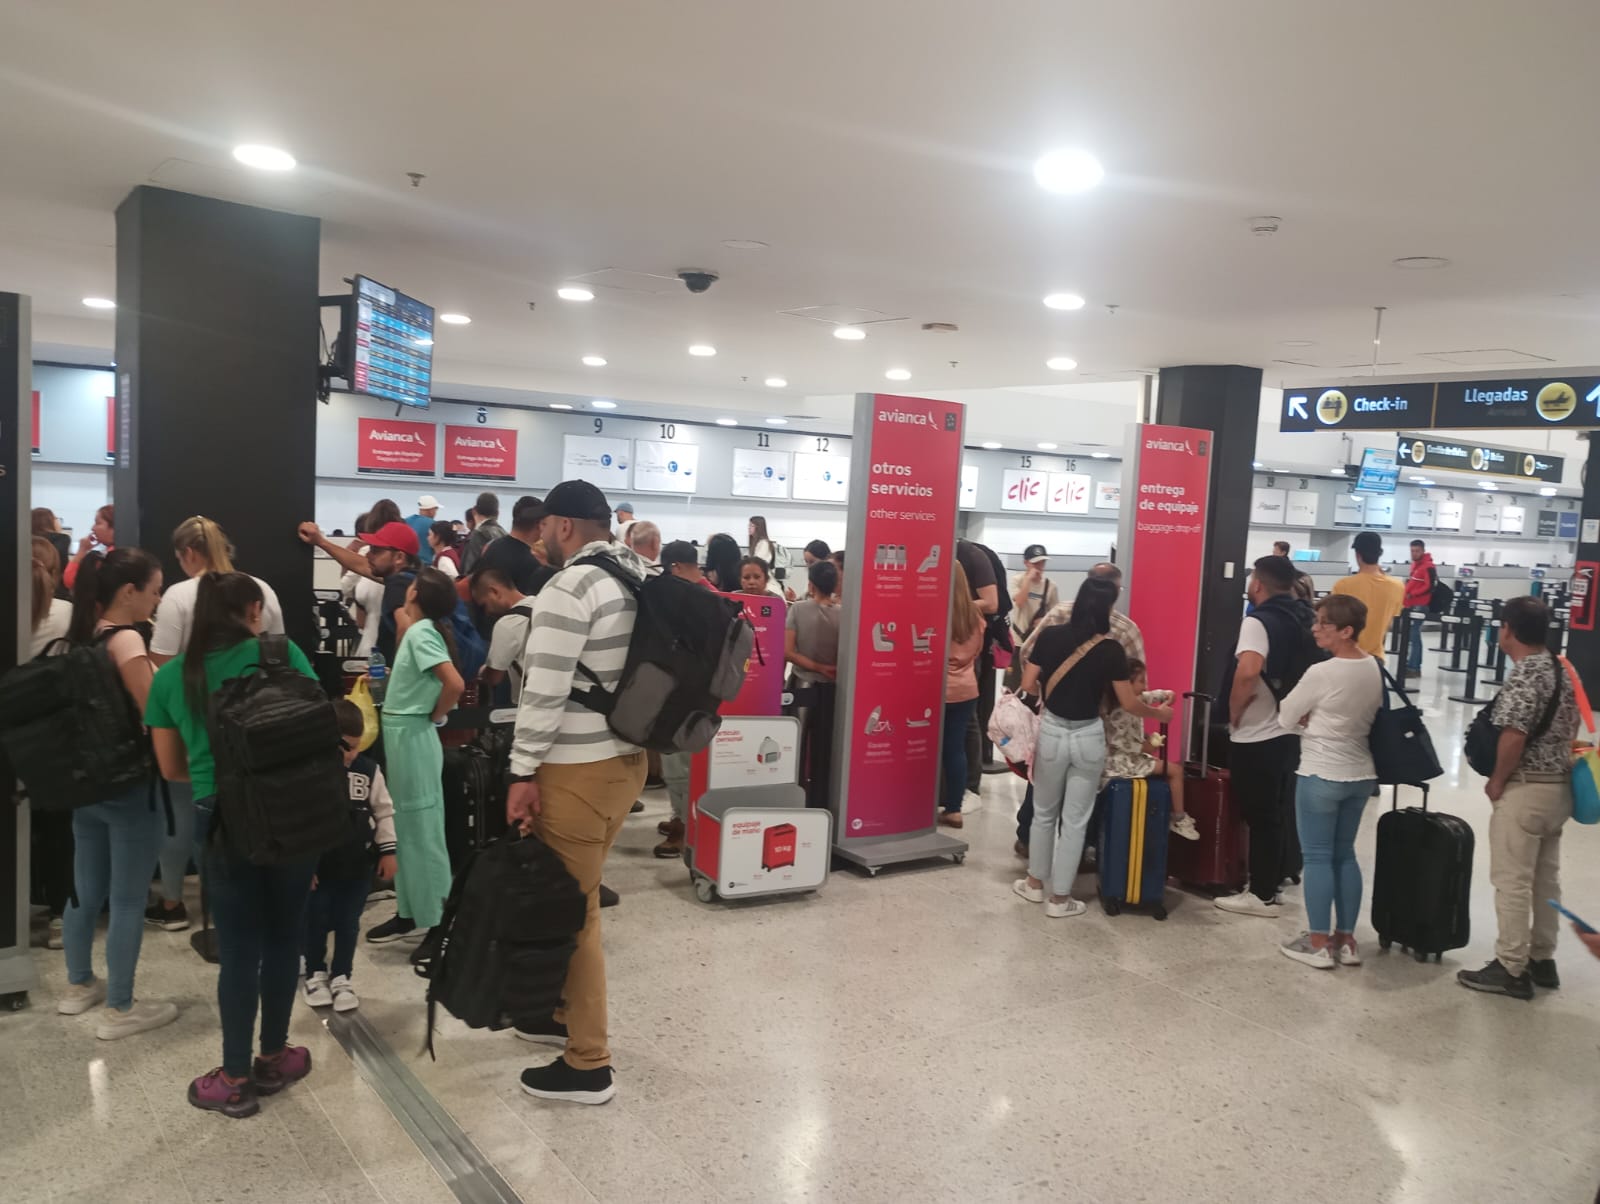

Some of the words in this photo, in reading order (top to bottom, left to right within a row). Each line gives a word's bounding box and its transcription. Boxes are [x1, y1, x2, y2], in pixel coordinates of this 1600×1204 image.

[1464, 387, 1529, 405] Llegadas
[1354, 397, 1408, 412] Check-in
[878, 408, 927, 425] avianca
[594, 418, 603, 433] 9
[660, 424, 676, 439] 10
[369, 429, 413, 443] Avianca
[454, 436, 495, 449] Avianca
[757, 432, 770, 447] 11
[816, 438, 829, 452] 12
[1145, 438, 1185, 452] avianca
[872, 462, 912, 476] otros
[1021, 456, 1032, 468] 15
[1065, 459, 1077, 471] 16
[871, 482, 933, 497] servicios
[1007, 477, 1041, 503] clic
[1054, 481, 1085, 504] clic
[1140, 483, 1185, 498] entrega
[870, 508, 898, 520] other
[900, 510, 936, 521] services
[1139, 499, 1155, 510] de
[1157, 500, 1199, 515] equipaje
[347, 771, 370, 800] B
